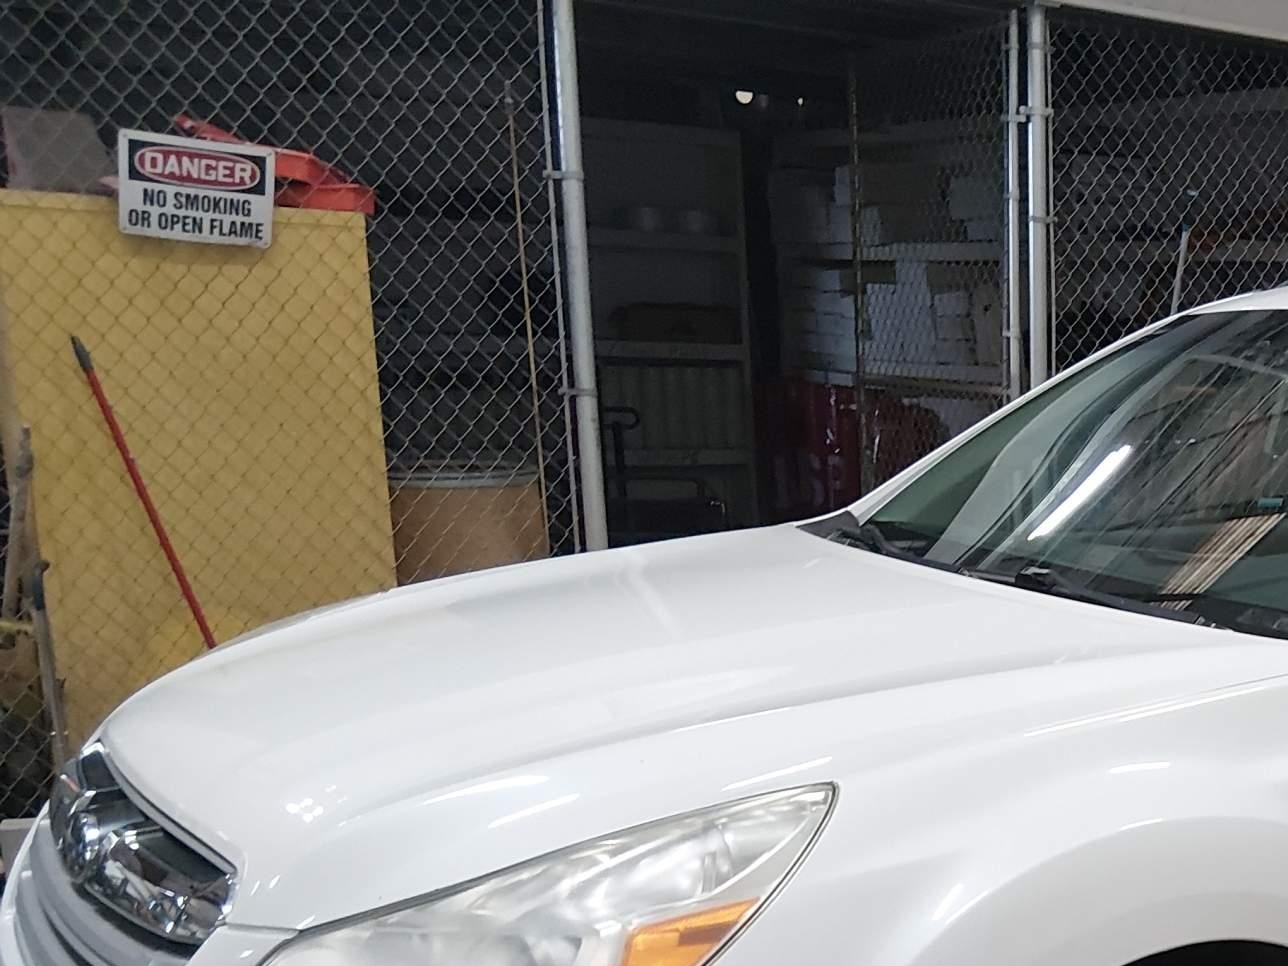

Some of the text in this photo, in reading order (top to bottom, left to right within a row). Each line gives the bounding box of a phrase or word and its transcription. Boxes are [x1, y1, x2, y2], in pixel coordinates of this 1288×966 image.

[143, 152, 253, 185] DANGER
[142, 188, 252, 217] NO SMOKING
[128, 209, 264, 241] OR OPEN FLAME
